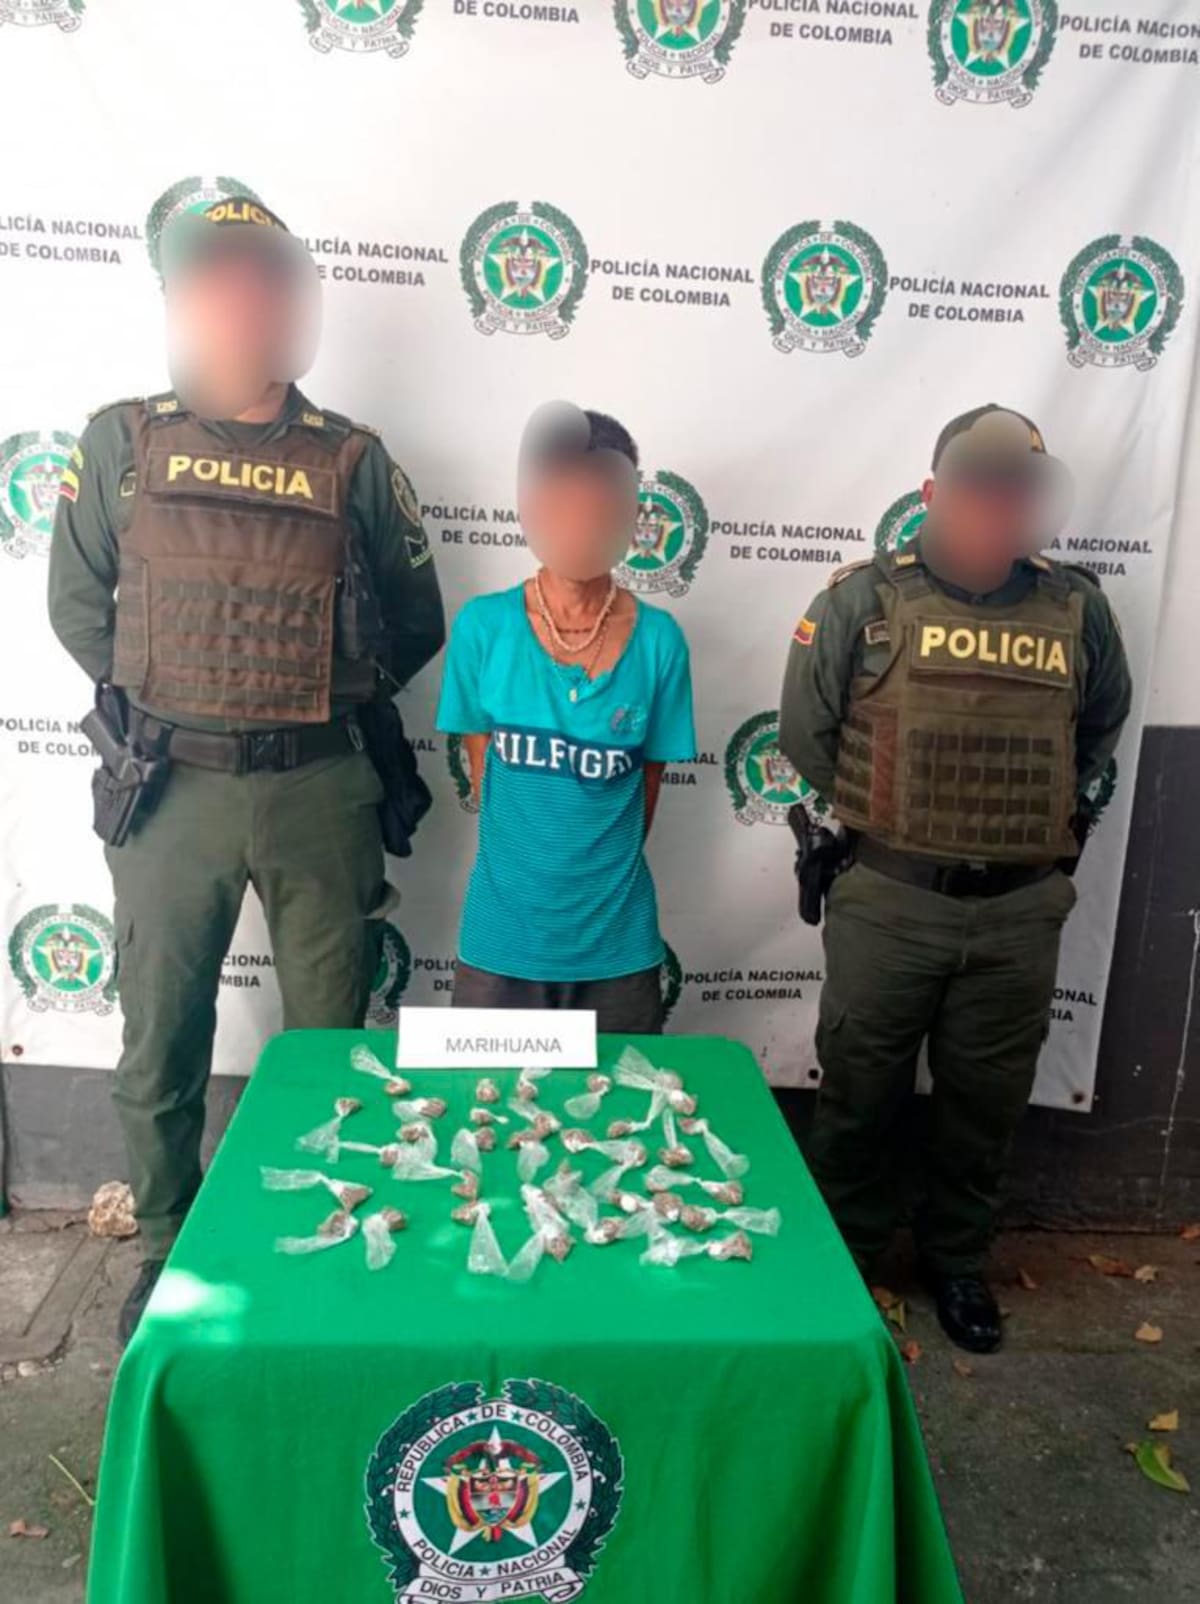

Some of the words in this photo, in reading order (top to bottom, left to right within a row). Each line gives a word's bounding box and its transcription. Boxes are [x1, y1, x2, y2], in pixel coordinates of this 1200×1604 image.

[453, 0, 477, 16] DE
[483, 2, 579, 23] COLOMBIA
[827, 1, 919, 18] NACIONAL
[770, 22, 793, 37] DE
[799, 24, 893, 45] COLOMBIA
[1060, 15, 1131, 33] POLICÍA
[1080, 44, 1103, 59] DE
[1109, 44, 1199, 64] COLOMBIA
[205, 202, 273, 226] OLIC
[51, 220, 143, 240] NACIONAL
[0, 242, 20, 257] DE
[26, 243, 121, 264] COLOMBIA
[358, 242, 448, 263] NACIONAL
[332, 265, 425, 286] COLOMBIA
[590, 259, 660, 278] POLICÍA
[665, 263, 754, 283] NACIONAL
[612, 285, 634, 300] DE
[640, 288, 730, 307] COLOMBIA
[889, 276, 956, 295] POLICÍA
[961, 282, 1050, 298] NACIONAL
[908, 303, 930, 318] DE
[935, 305, 1024, 322] COLOMBIA
[167, 455, 313, 499] POLICIA
[421, 504, 487, 522] POLICÍA
[442, 529, 464, 544] DE
[711, 520, 776, 538] POLICÍA
[782, 524, 866, 541] NACIONAL
[730, 546, 752, 559] DE
[757, 547, 842, 563] COLOMBIA
[1067, 537, 1152, 554] NACIONAL
[920, 625, 1068, 675] POLICIA
[18, 741, 40, 754] DE
[433, 980, 455, 992] DE
[684, 968, 743, 984] POLICÍA
[748, 970, 823, 982] NACIONAL
[702, 990, 722, 1002] DE
[726, 988, 802, 1000] COLOMBIA
[445, 1037, 562, 1053] MARIHUANA
[397, 1415, 466, 1493] REPUBLICA
[481, 1403, 508, 1418] DE
[525, 1412, 590, 1482] COLOMBIA
[413, 1538, 476, 1577] POLICIA
[497, 1526, 578, 1576] NACIONAL
[420, 1579, 463, 1599] DIOS
[475, 1587, 488, 1599] Y
[501, 1570, 565, 1595] PATRIA
